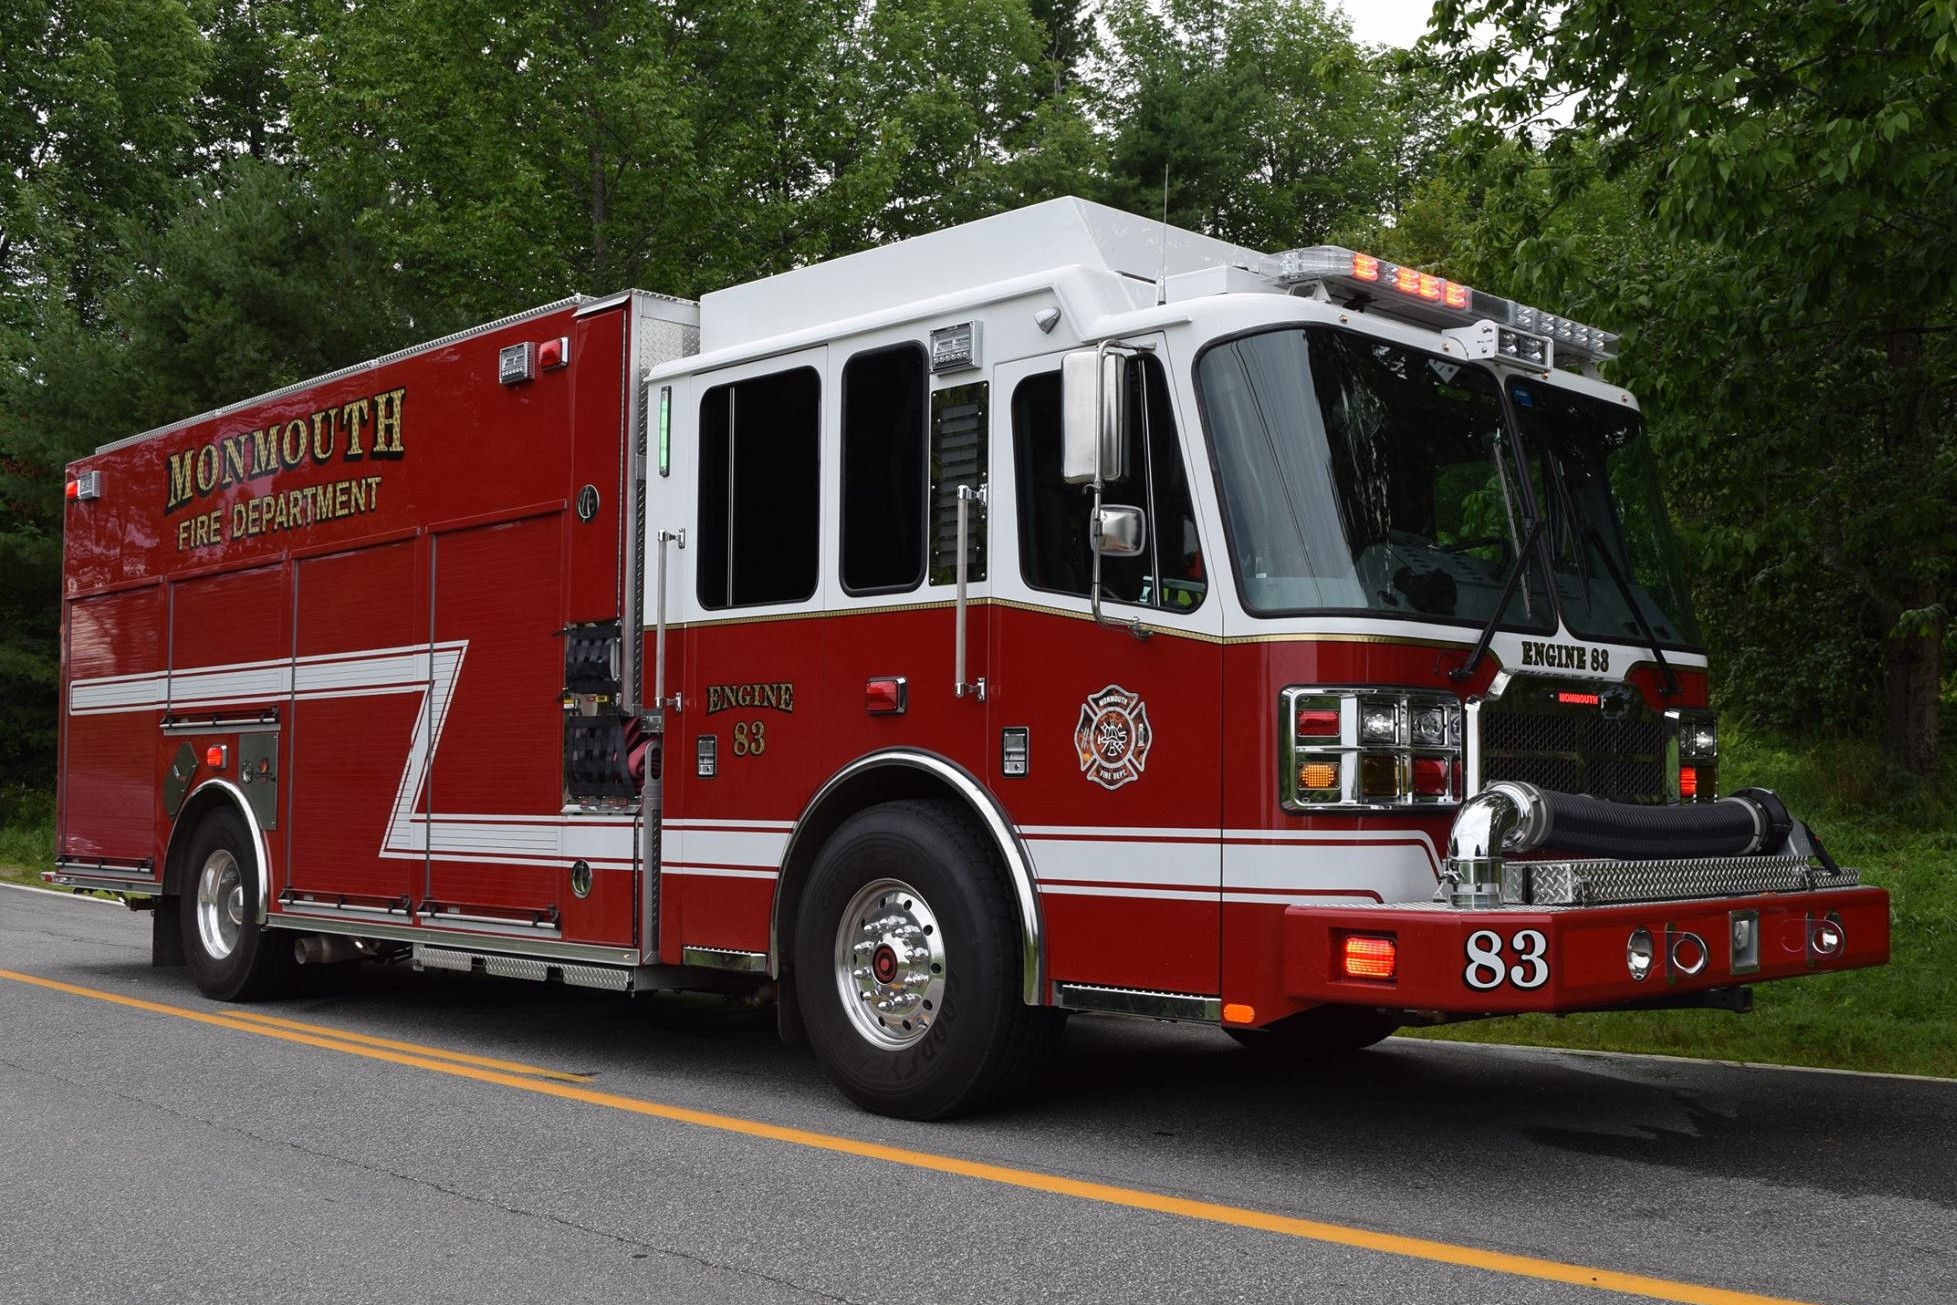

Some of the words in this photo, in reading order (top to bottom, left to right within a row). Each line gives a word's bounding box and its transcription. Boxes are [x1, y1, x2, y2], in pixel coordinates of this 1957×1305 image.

[165, 387, 406, 514] MONMOUTH
[178, 510, 222, 550] FIRE
[232, 477, 381, 538] DEPARTMENT
[1521, 641, 1586, 670] ENGINE
[1591, 648, 1609, 672] 83
[706, 683, 793, 715] ENGINE
[1099, 695, 1128, 706] MONMOUTH
[1559, 692, 1599, 704] MONMOUTH
[734, 721, 765, 756] 83
[1100, 769, 1111, 779] FIRE
[1464, 929, 1549, 991] 83
